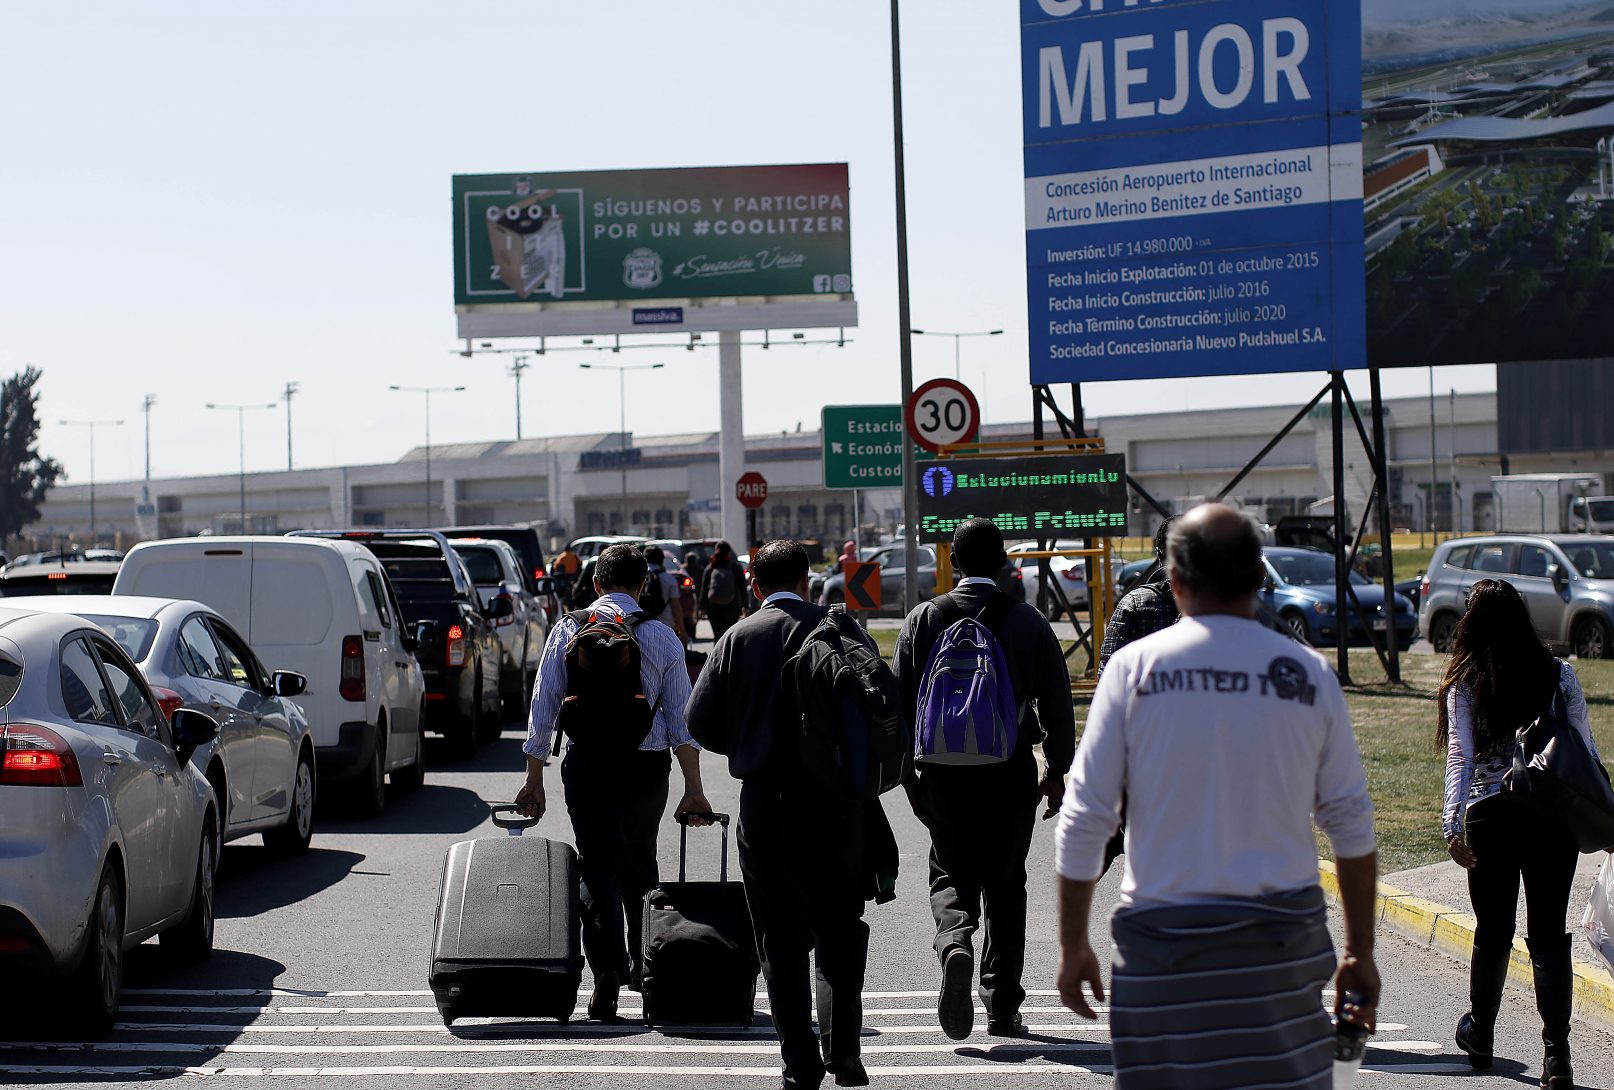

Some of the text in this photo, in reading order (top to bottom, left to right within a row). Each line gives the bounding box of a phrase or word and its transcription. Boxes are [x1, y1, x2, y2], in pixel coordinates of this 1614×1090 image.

[1039, 17, 1311, 128] MEJOR
[1046, 155, 1312, 198] Concesión Aeropuerto Internacional
[593, 194, 844, 217] SÍGUENOS Y PARTICIPA
[1047, 207, 1091, 222] Arturo
[1096, 200, 1147, 218] Merino
[1211, 190, 1230, 206] de
[1234, 185, 1302, 204] Santiago
[594, 216, 843, 239] POR UN #COOLITZER
[1047, 245, 1106, 262] Inversión:
[1108, 243, 1123, 257] UF
[1127, 236, 1193, 256] 14.980.000
[1048, 252, 1319, 288] Fecha Inicio Explotación: 01 de octubre 2015
[1049, 280, 1269, 311] Fecha Inicio Construcción: julio 2016
[1050, 320, 1083, 335] Fecha
[1137, 310, 1222, 329] Construcción:
[1224, 308, 1251, 326] julio
[1254, 304, 1286, 321] 2020
[1050, 327, 1326, 359] Sociedad Concesionaria Nuevo Pudahuel S.A.
[848, 420, 903, 433] Estacio
[920, 398, 966, 432] 30
[849, 464, 902, 477] Custod
[738, 483, 767, 498] PARE
[1136, 667, 1248, 696] LIMITED
